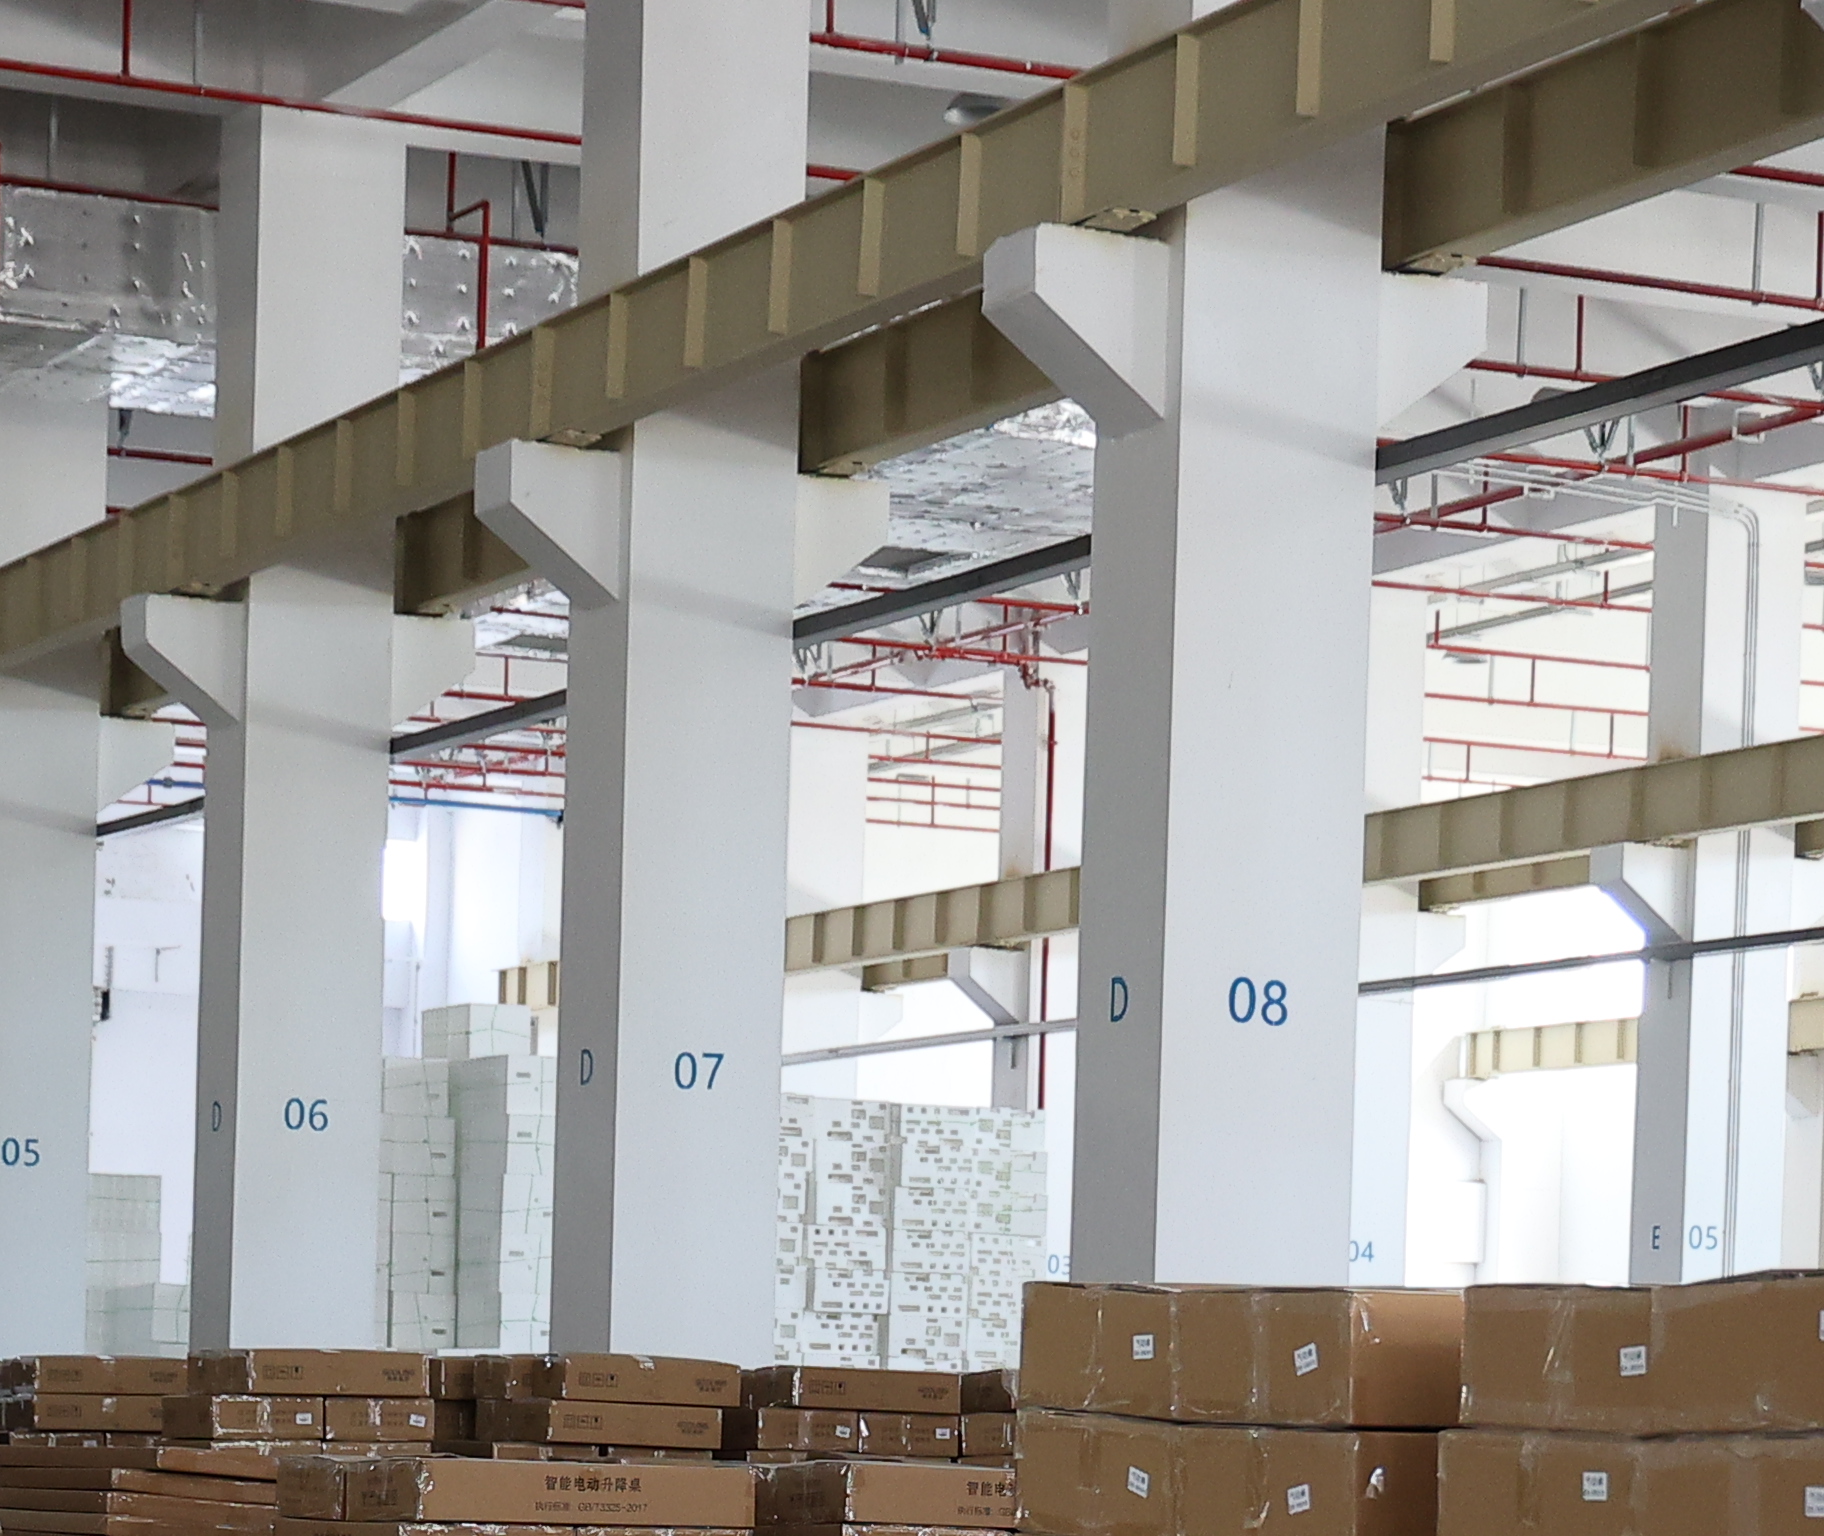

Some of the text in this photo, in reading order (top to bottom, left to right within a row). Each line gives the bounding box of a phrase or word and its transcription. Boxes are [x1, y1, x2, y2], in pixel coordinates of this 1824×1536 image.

[1110, 976, 1129, 1023] D
[1228, 976, 1288, 1026] 08
[580, 1048, 594, 1086] D
[674, 1052, 724, 1090] 07
[212, 1100, 222, 1132] D
[284, 1097, 329, 1131] 06
[1, 1137, 40, 1167] 05
[1348, 1240, 1374, 1262] 04
[1652, 1225, 1662, 1250] E
[1688, 1225, 1718, 1251] 05
[544, 1474, 643, 1493] 智能电动升降桌
